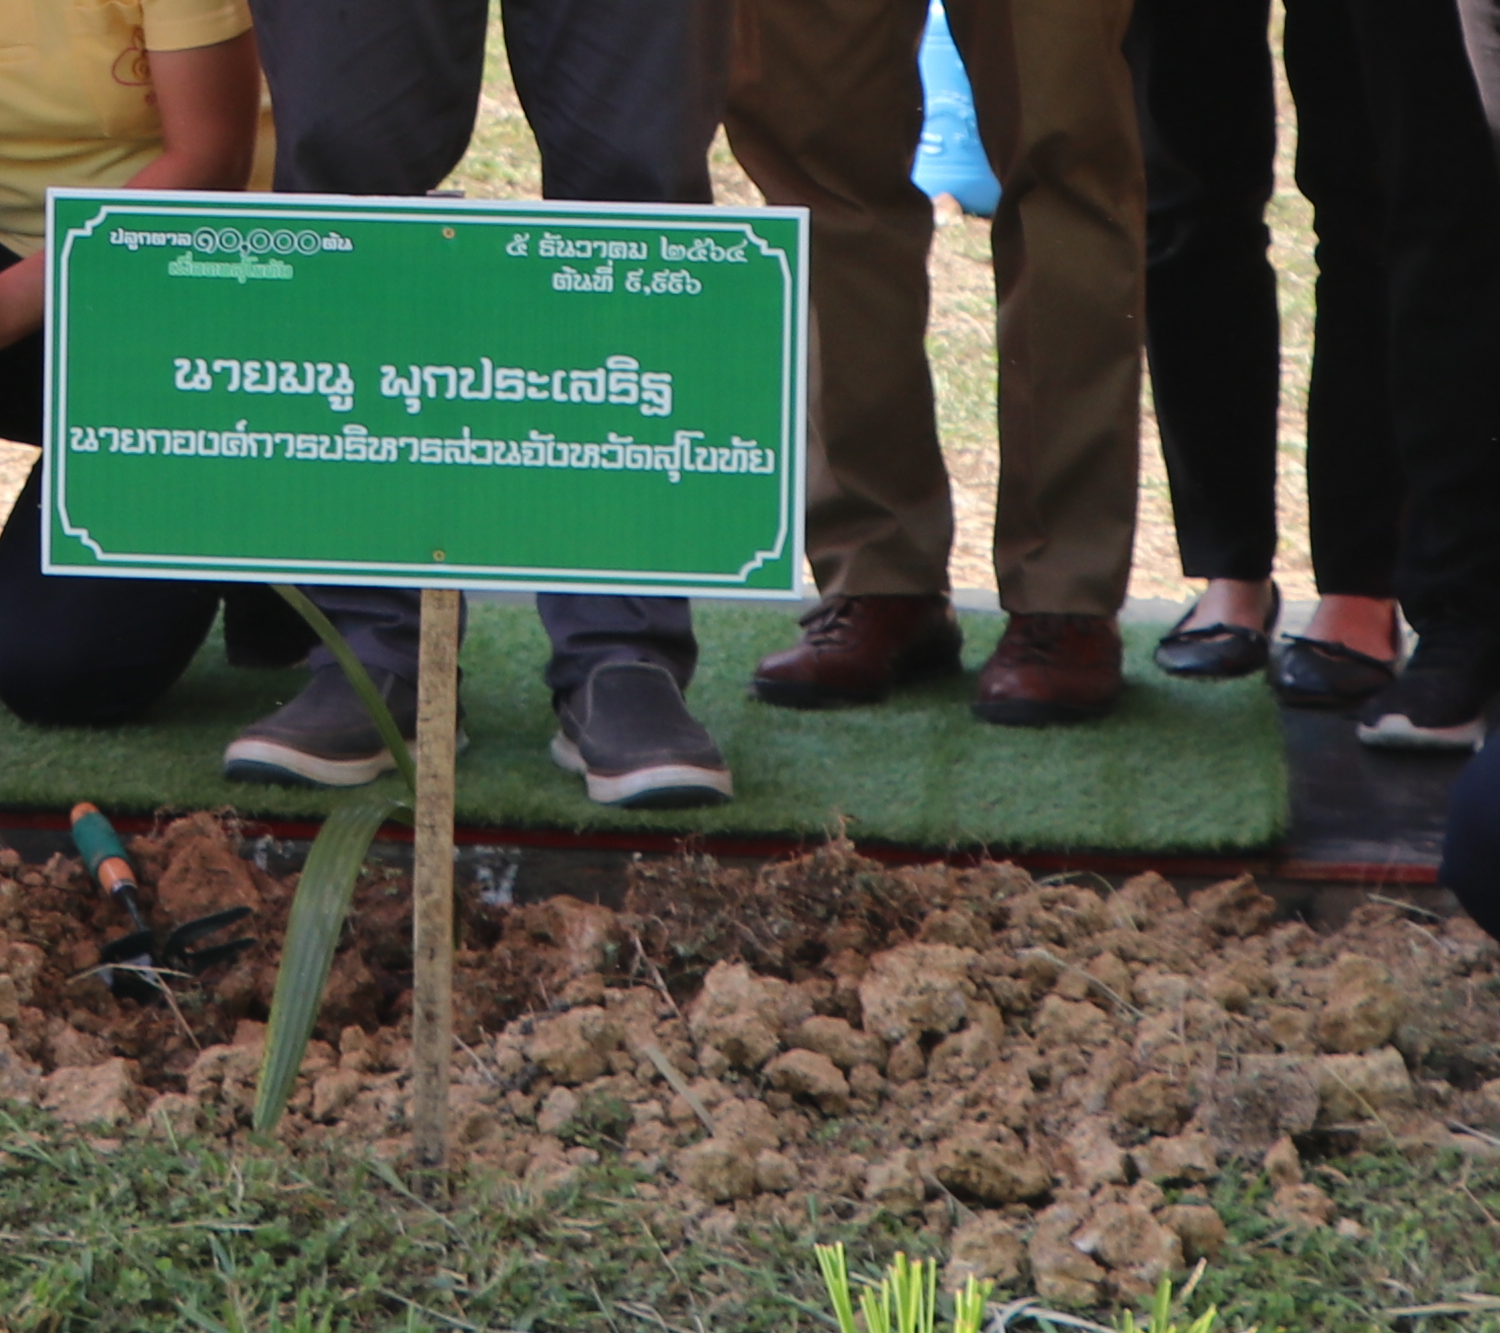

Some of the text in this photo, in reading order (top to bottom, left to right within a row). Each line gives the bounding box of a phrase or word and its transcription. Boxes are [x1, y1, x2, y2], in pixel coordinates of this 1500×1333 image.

[506, 232, 748, 263] ๕ ธันวาคม ๒๕๖๔
[552, 260, 614, 292] ต้นที่
[174, 355, 673, 416] นายมนู พุกประเสริฐ
[69, 419, 775, 483] นายกองค์การบริหารส่วนจังหวัดสุโขทัย
